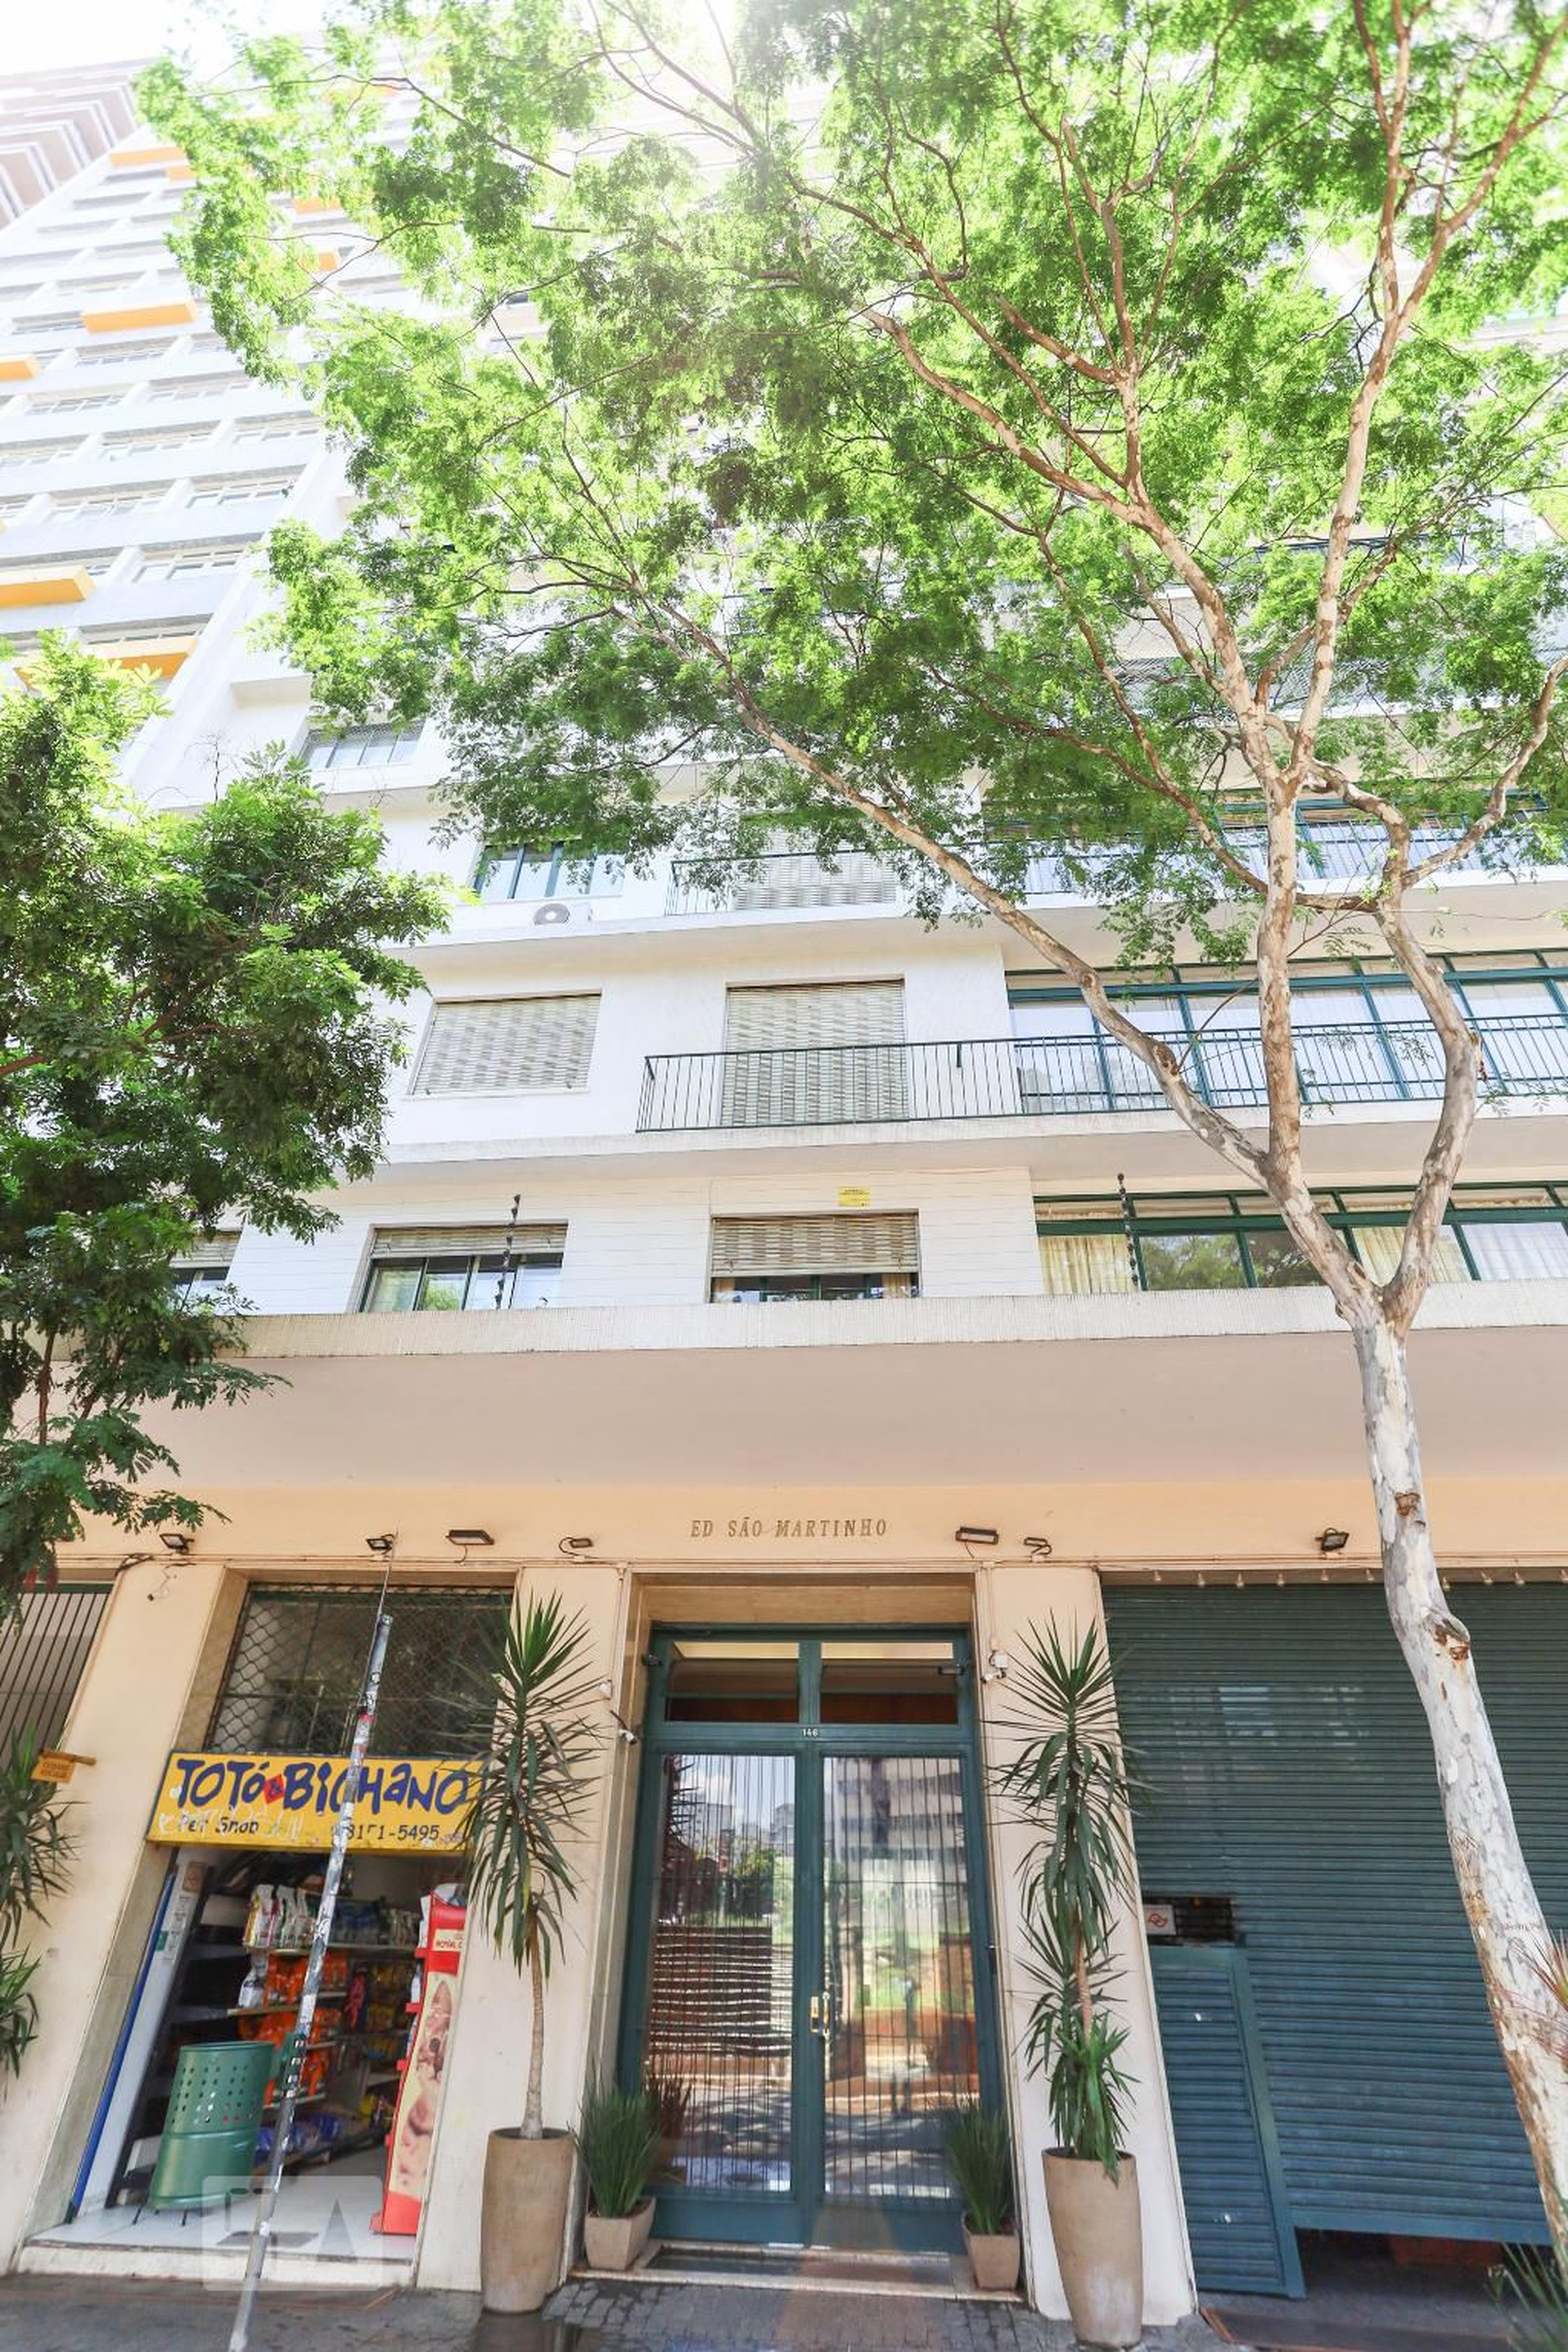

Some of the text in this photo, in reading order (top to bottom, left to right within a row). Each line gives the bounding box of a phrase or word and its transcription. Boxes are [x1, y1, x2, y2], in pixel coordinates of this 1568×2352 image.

[691, 1517, 886, 1537] ED SÃO MARTINHO
